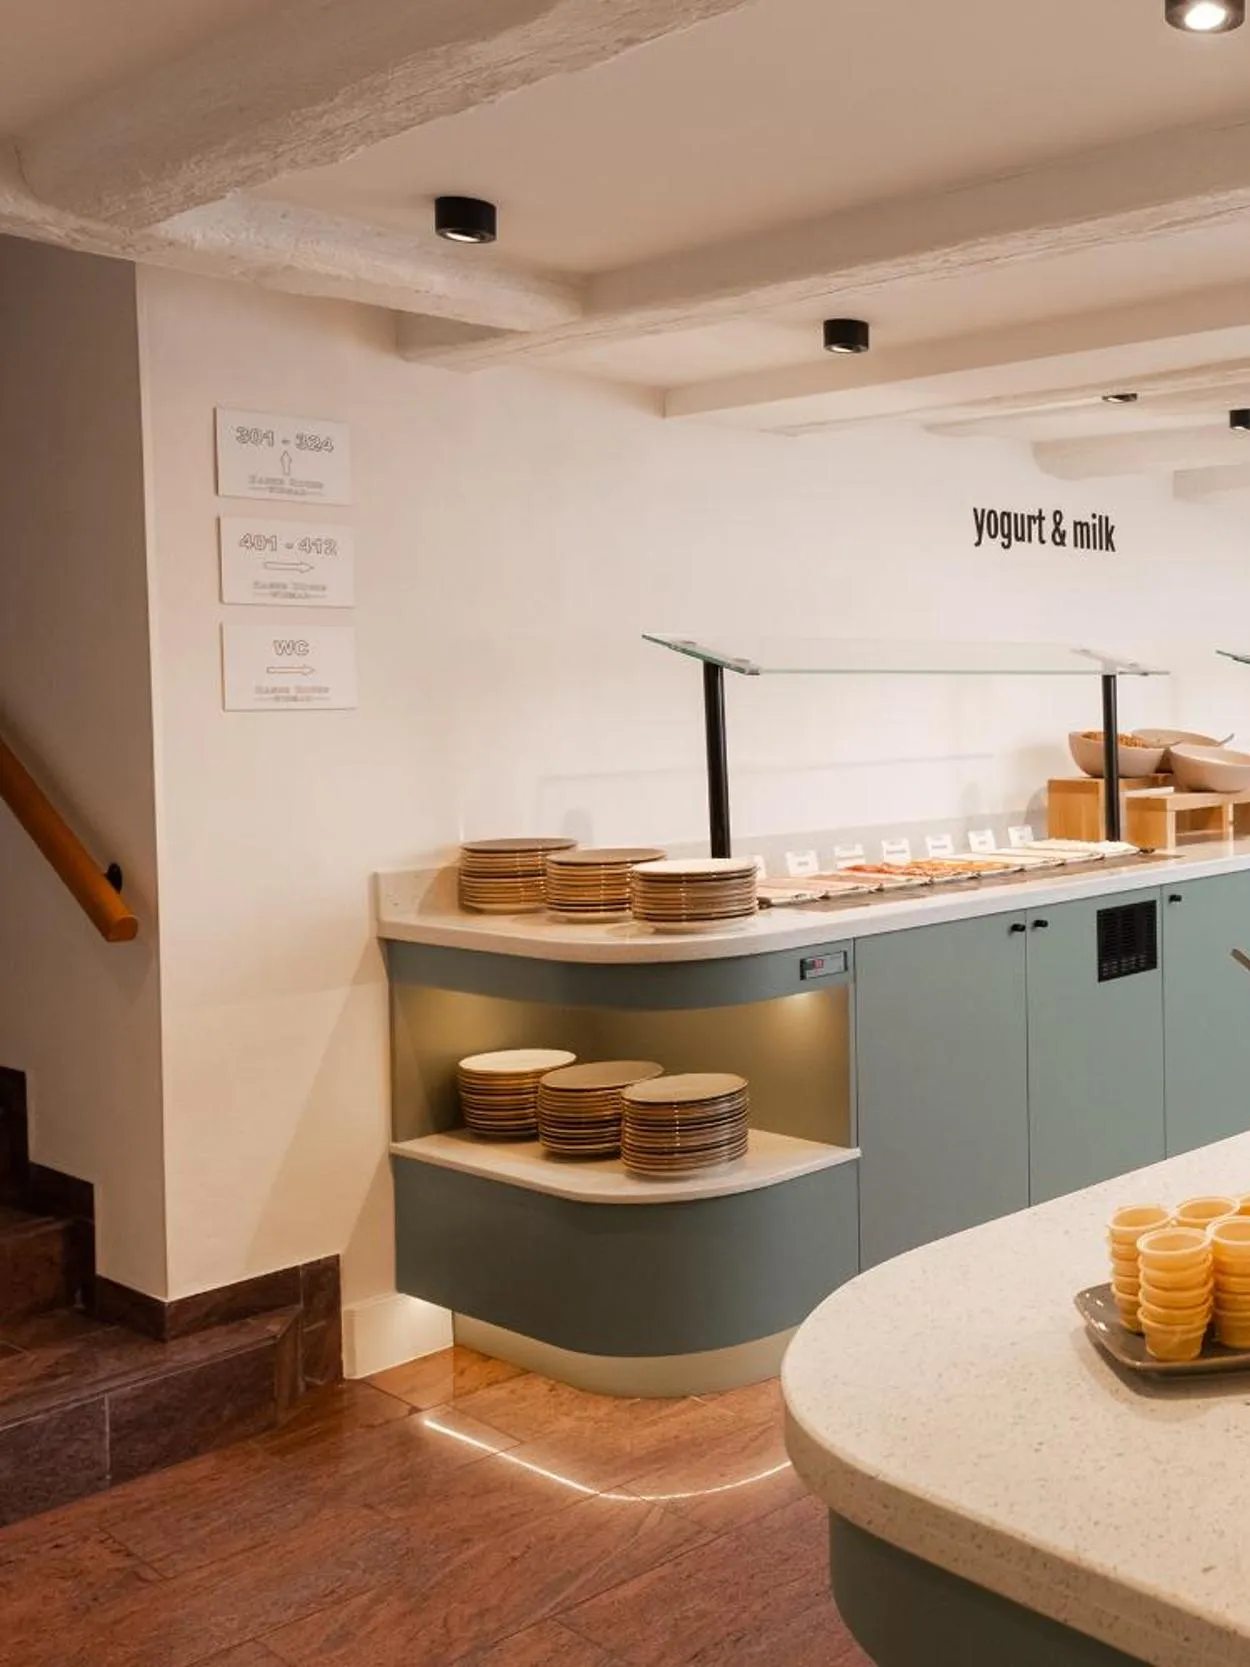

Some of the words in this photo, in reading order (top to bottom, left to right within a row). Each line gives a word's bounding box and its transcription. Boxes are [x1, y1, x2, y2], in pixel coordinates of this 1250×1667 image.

[973, 507, 1046, 549] yogurt
[1051, 509, 1067, 547] &
[1073, 513, 1116, 552] milk
[239, 533, 278, 551] 401
[298, 536, 338, 556] 412
[272, 639, 310, 656] WC
